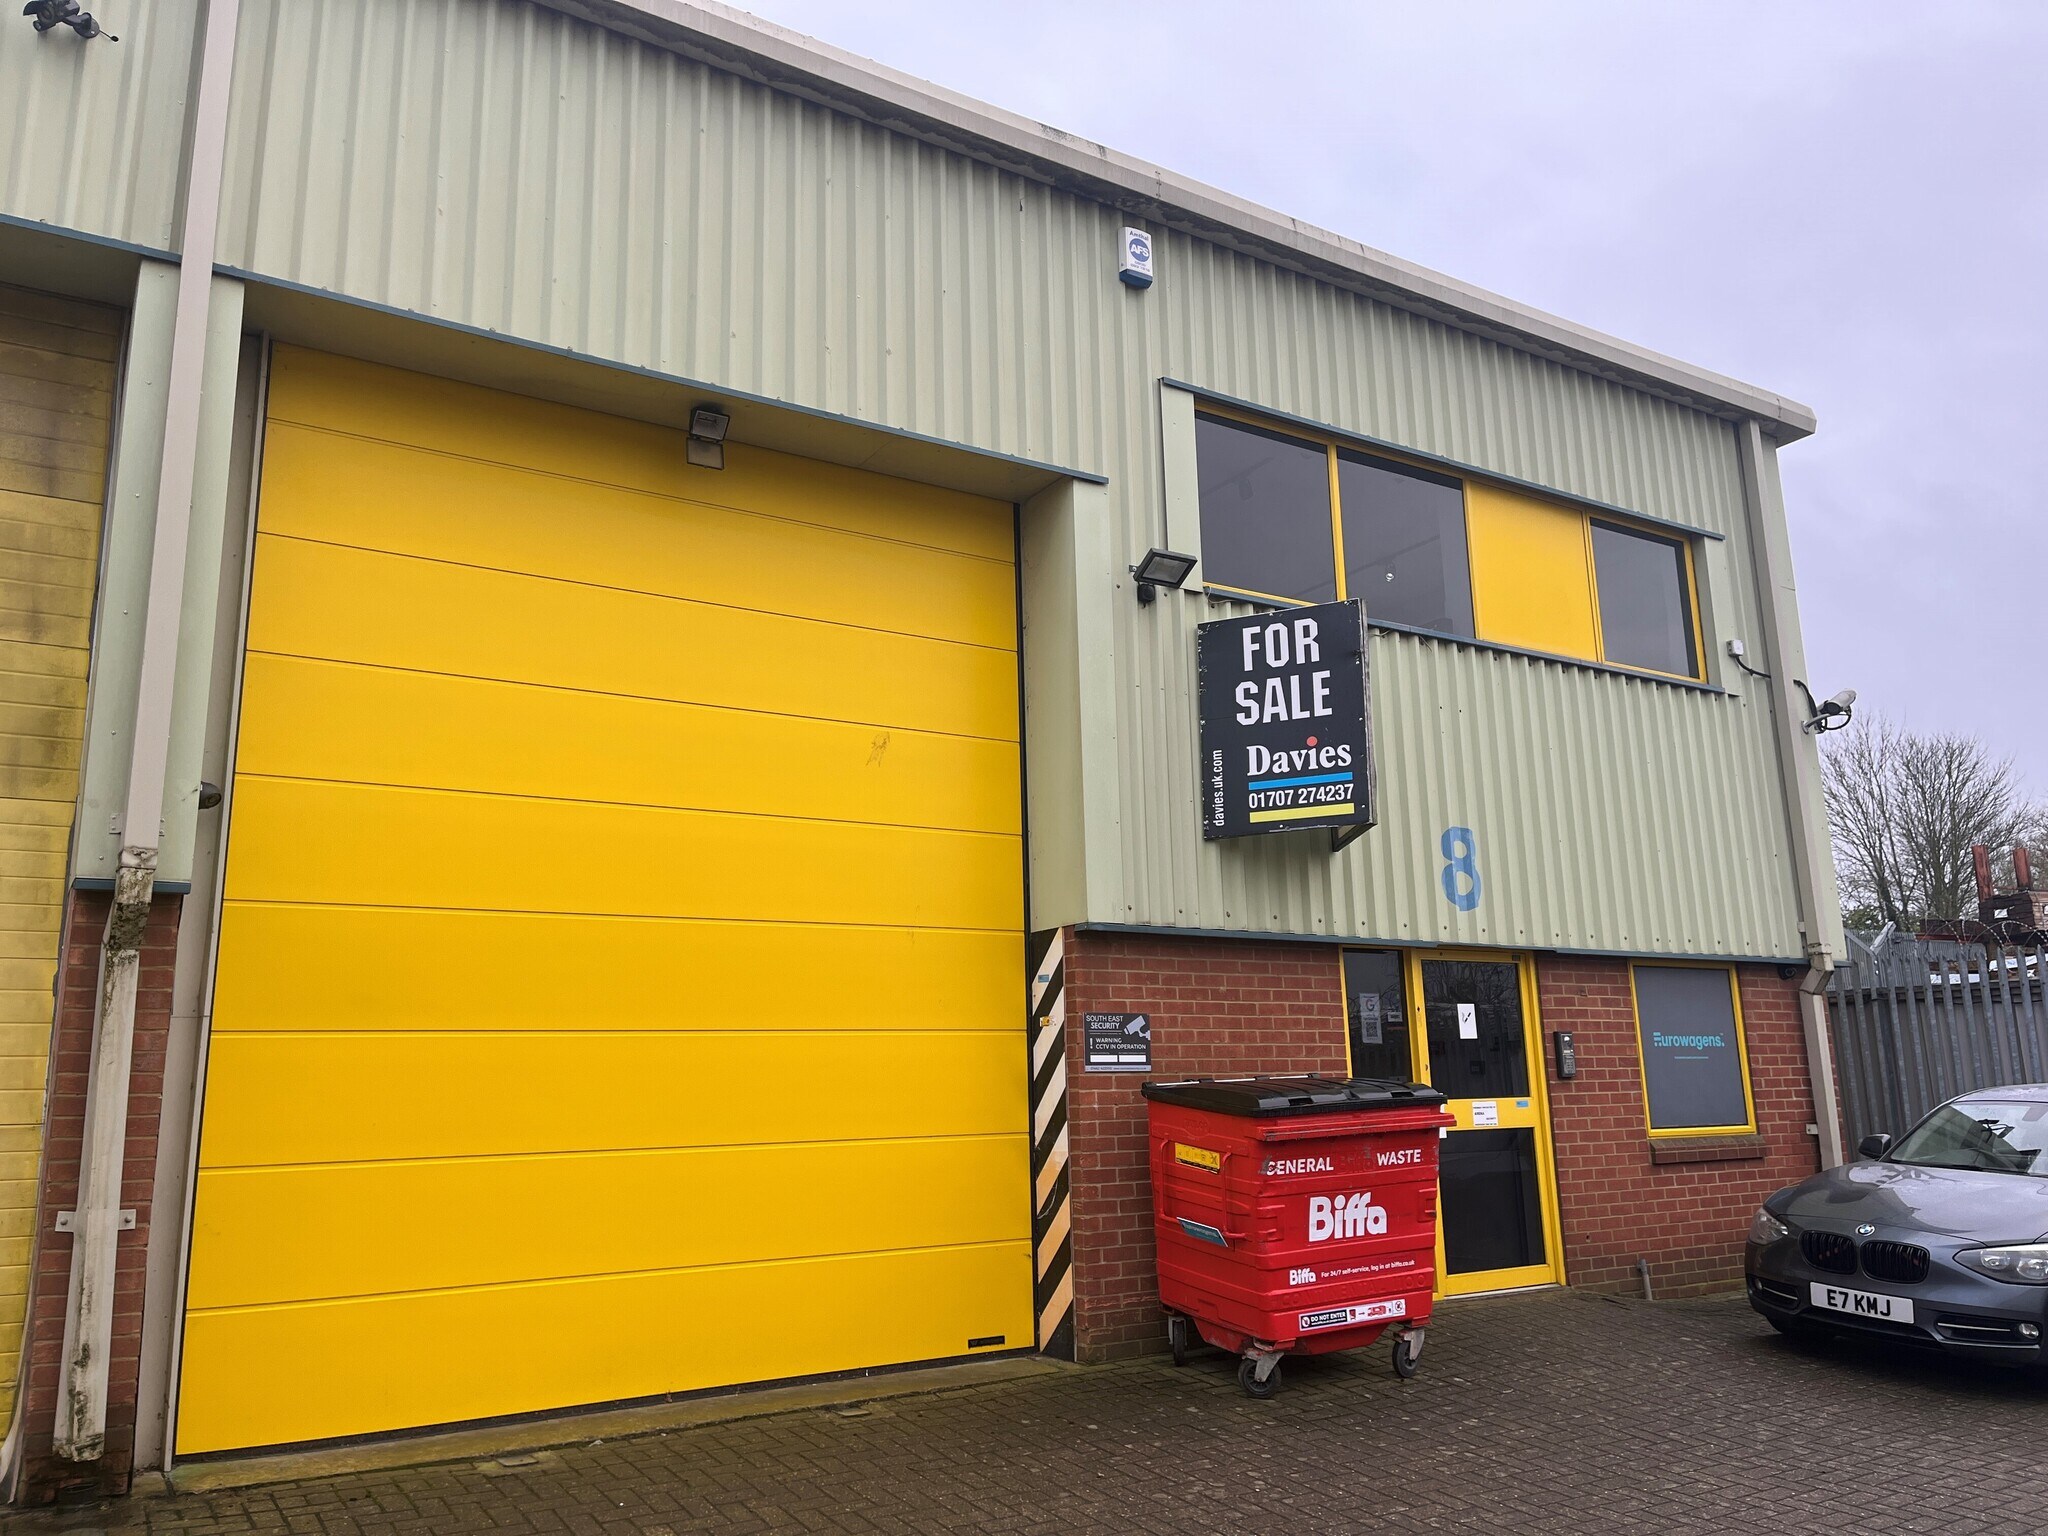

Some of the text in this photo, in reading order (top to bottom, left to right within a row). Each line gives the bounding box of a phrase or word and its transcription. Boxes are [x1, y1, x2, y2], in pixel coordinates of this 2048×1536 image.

[1130, 244, 1149, 257] AFS
[1242, 617, 1320, 672] FOR
[1235, 670, 1333, 726] SALE
[1246, 736, 1352, 776] Davies
[1212, 749, 1225, 827] davies.uk.com
[1248, 783, 1354, 809] 01707 274237
[1441, 826, 1482, 912] 8
[1266, 1157, 1334, 1175] GENERAL
[1377, 1149, 1422, 1166] WASTE
[1308, 1192, 1388, 1242] Biffa
[1289, 1267, 1316, 1285] Biffa
[1330, 1269, 1341, 1277] 24/7
[1371, 1264, 1379, 1272] log
[1330, 1311, 1346, 1319] ENTER
[1827, 1288, 1891, 1317] E7 KMJ
